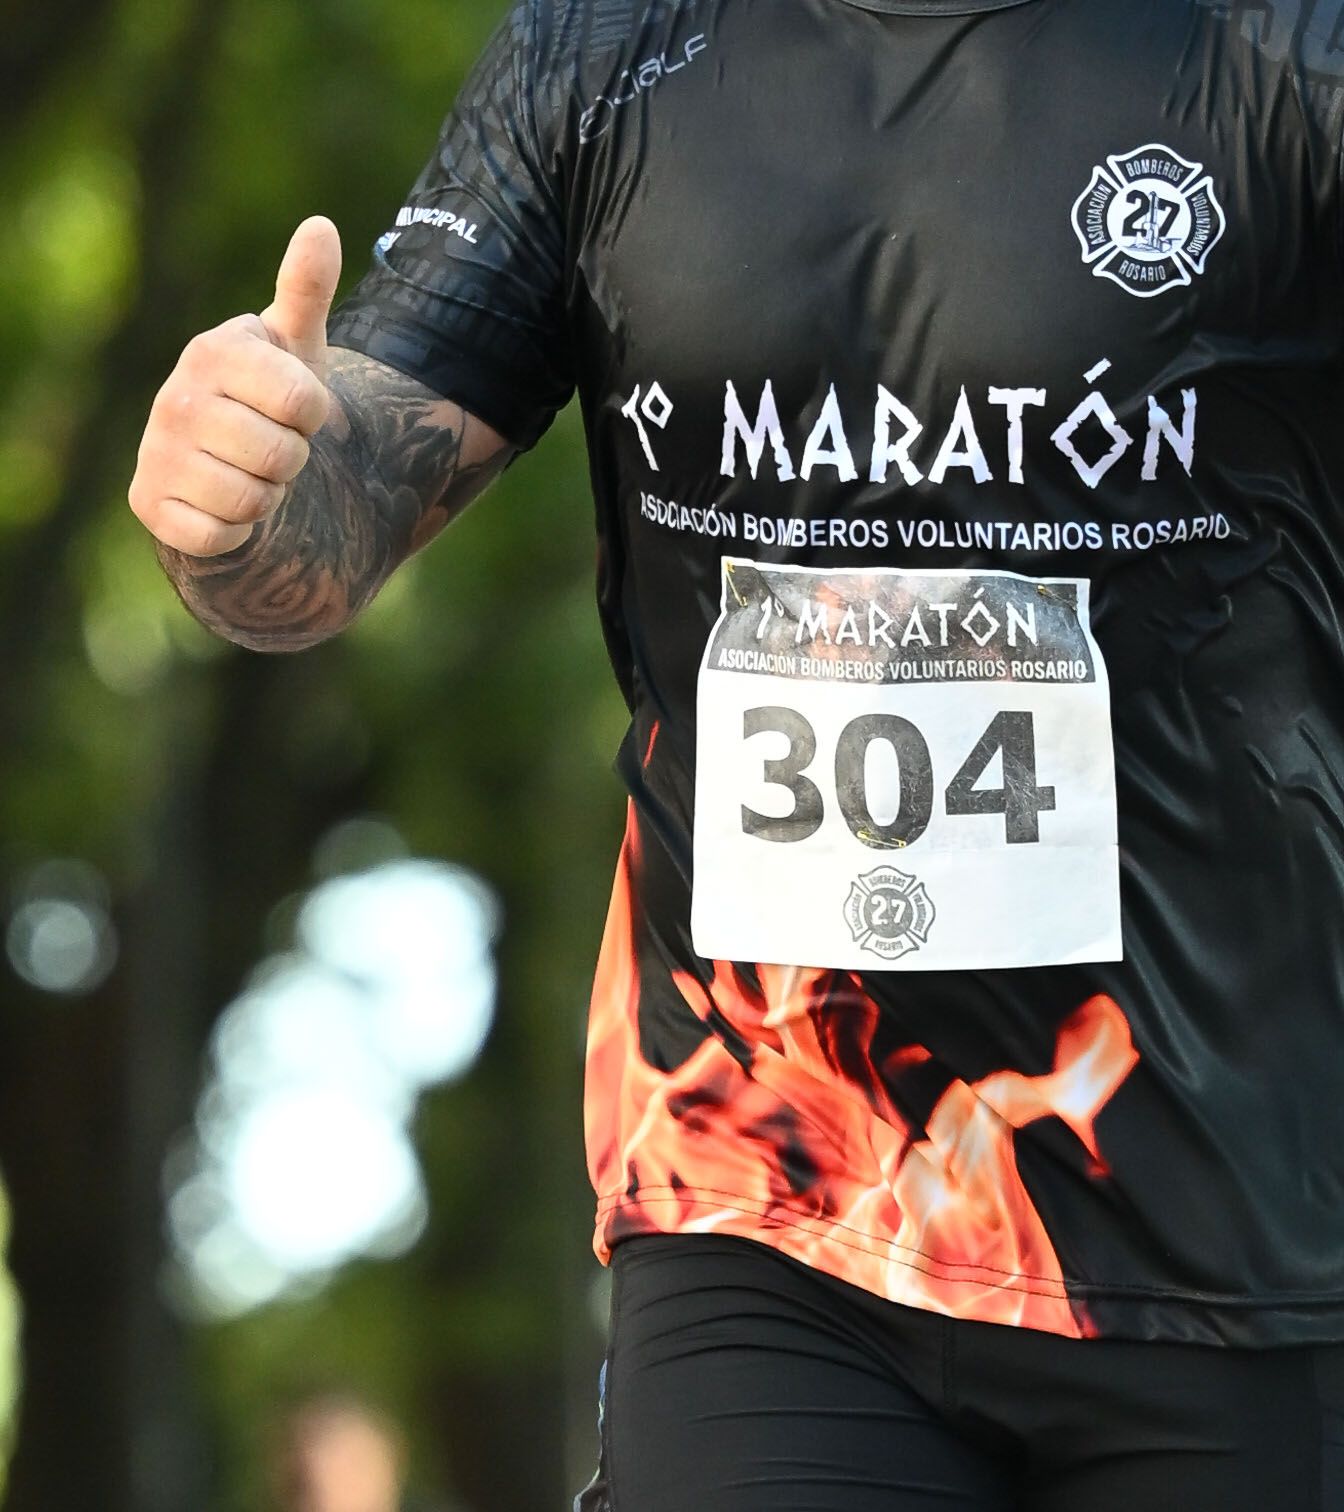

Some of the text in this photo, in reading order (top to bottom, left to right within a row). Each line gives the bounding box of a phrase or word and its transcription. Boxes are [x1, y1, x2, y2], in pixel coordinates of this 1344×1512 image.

[1125, 158, 1184, 182] BOMBEROS
[1086, 183, 1112, 245] ASOCIACIÓN
[1121, 189, 1181, 238] 27
[1186, 191, 1211, 257] VOLUNTARIOS
[1118, 259, 1167, 282] ROSARIO
[719, 357, 1197, 489] MARATÓN
[640, 491, 1231, 551] ASOCIACIÓN BOMBEROS VOLUNTARIOS ROSARIO
[795, 586, 1038, 648] MARATÓN
[717, 646, 1088, 681] ASOCIACIÓN BOMBEROS VOLUNTARIOS ROSARIO
[740, 705, 1056, 851] 304
[870, 893, 907, 925] 27
